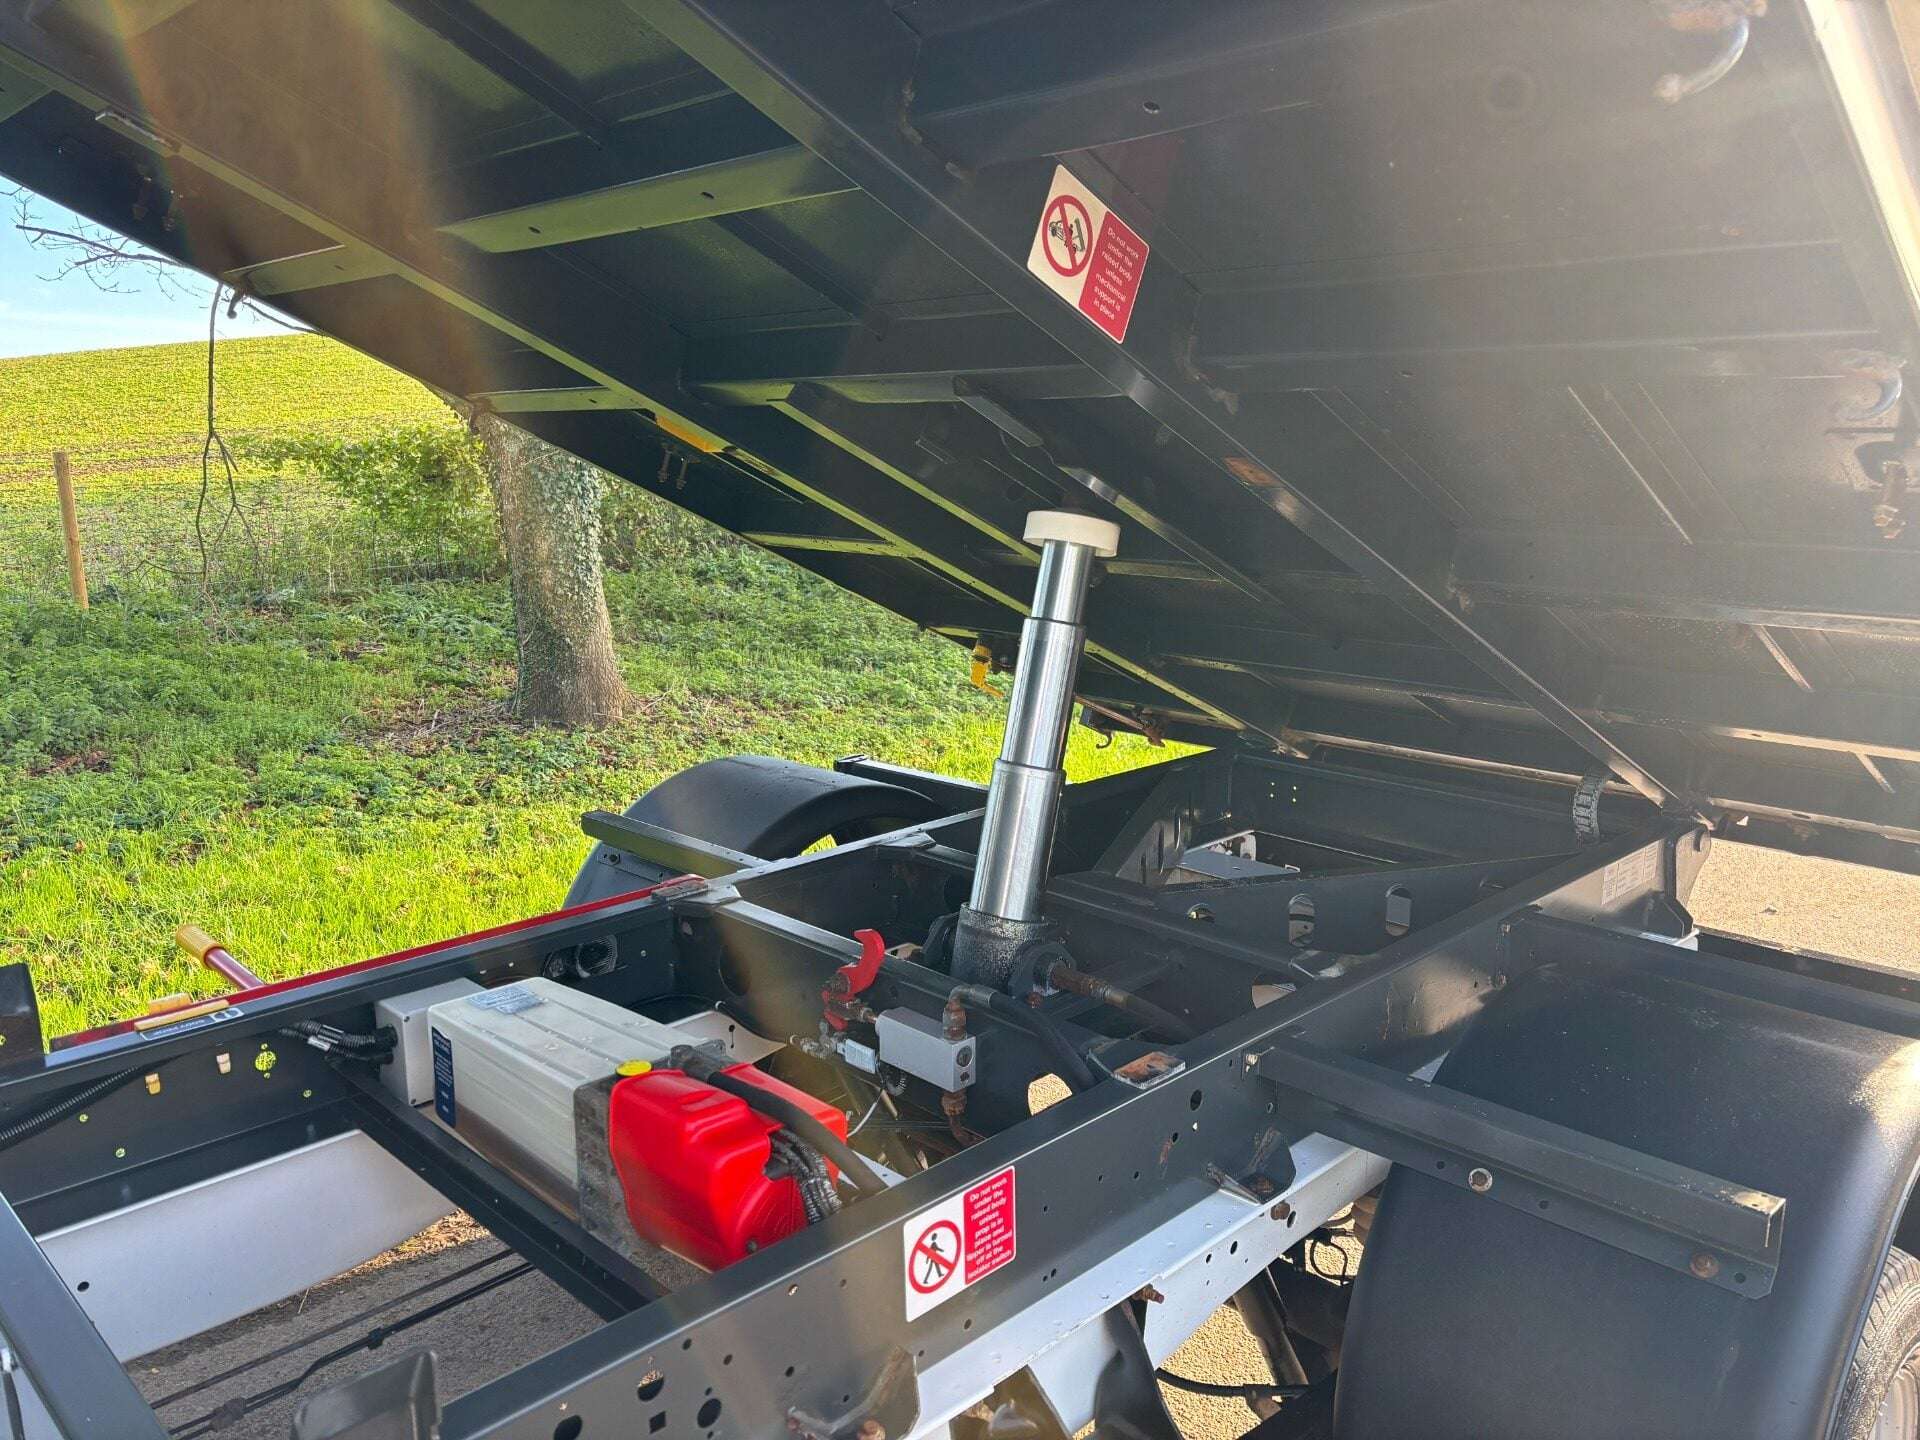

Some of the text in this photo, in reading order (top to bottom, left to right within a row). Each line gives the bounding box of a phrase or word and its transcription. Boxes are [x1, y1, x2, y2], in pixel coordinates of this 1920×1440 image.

[1117, 236, 1126, 248] not
[1102, 251, 1119, 269] raised
[1107, 243, 1123, 260] under
